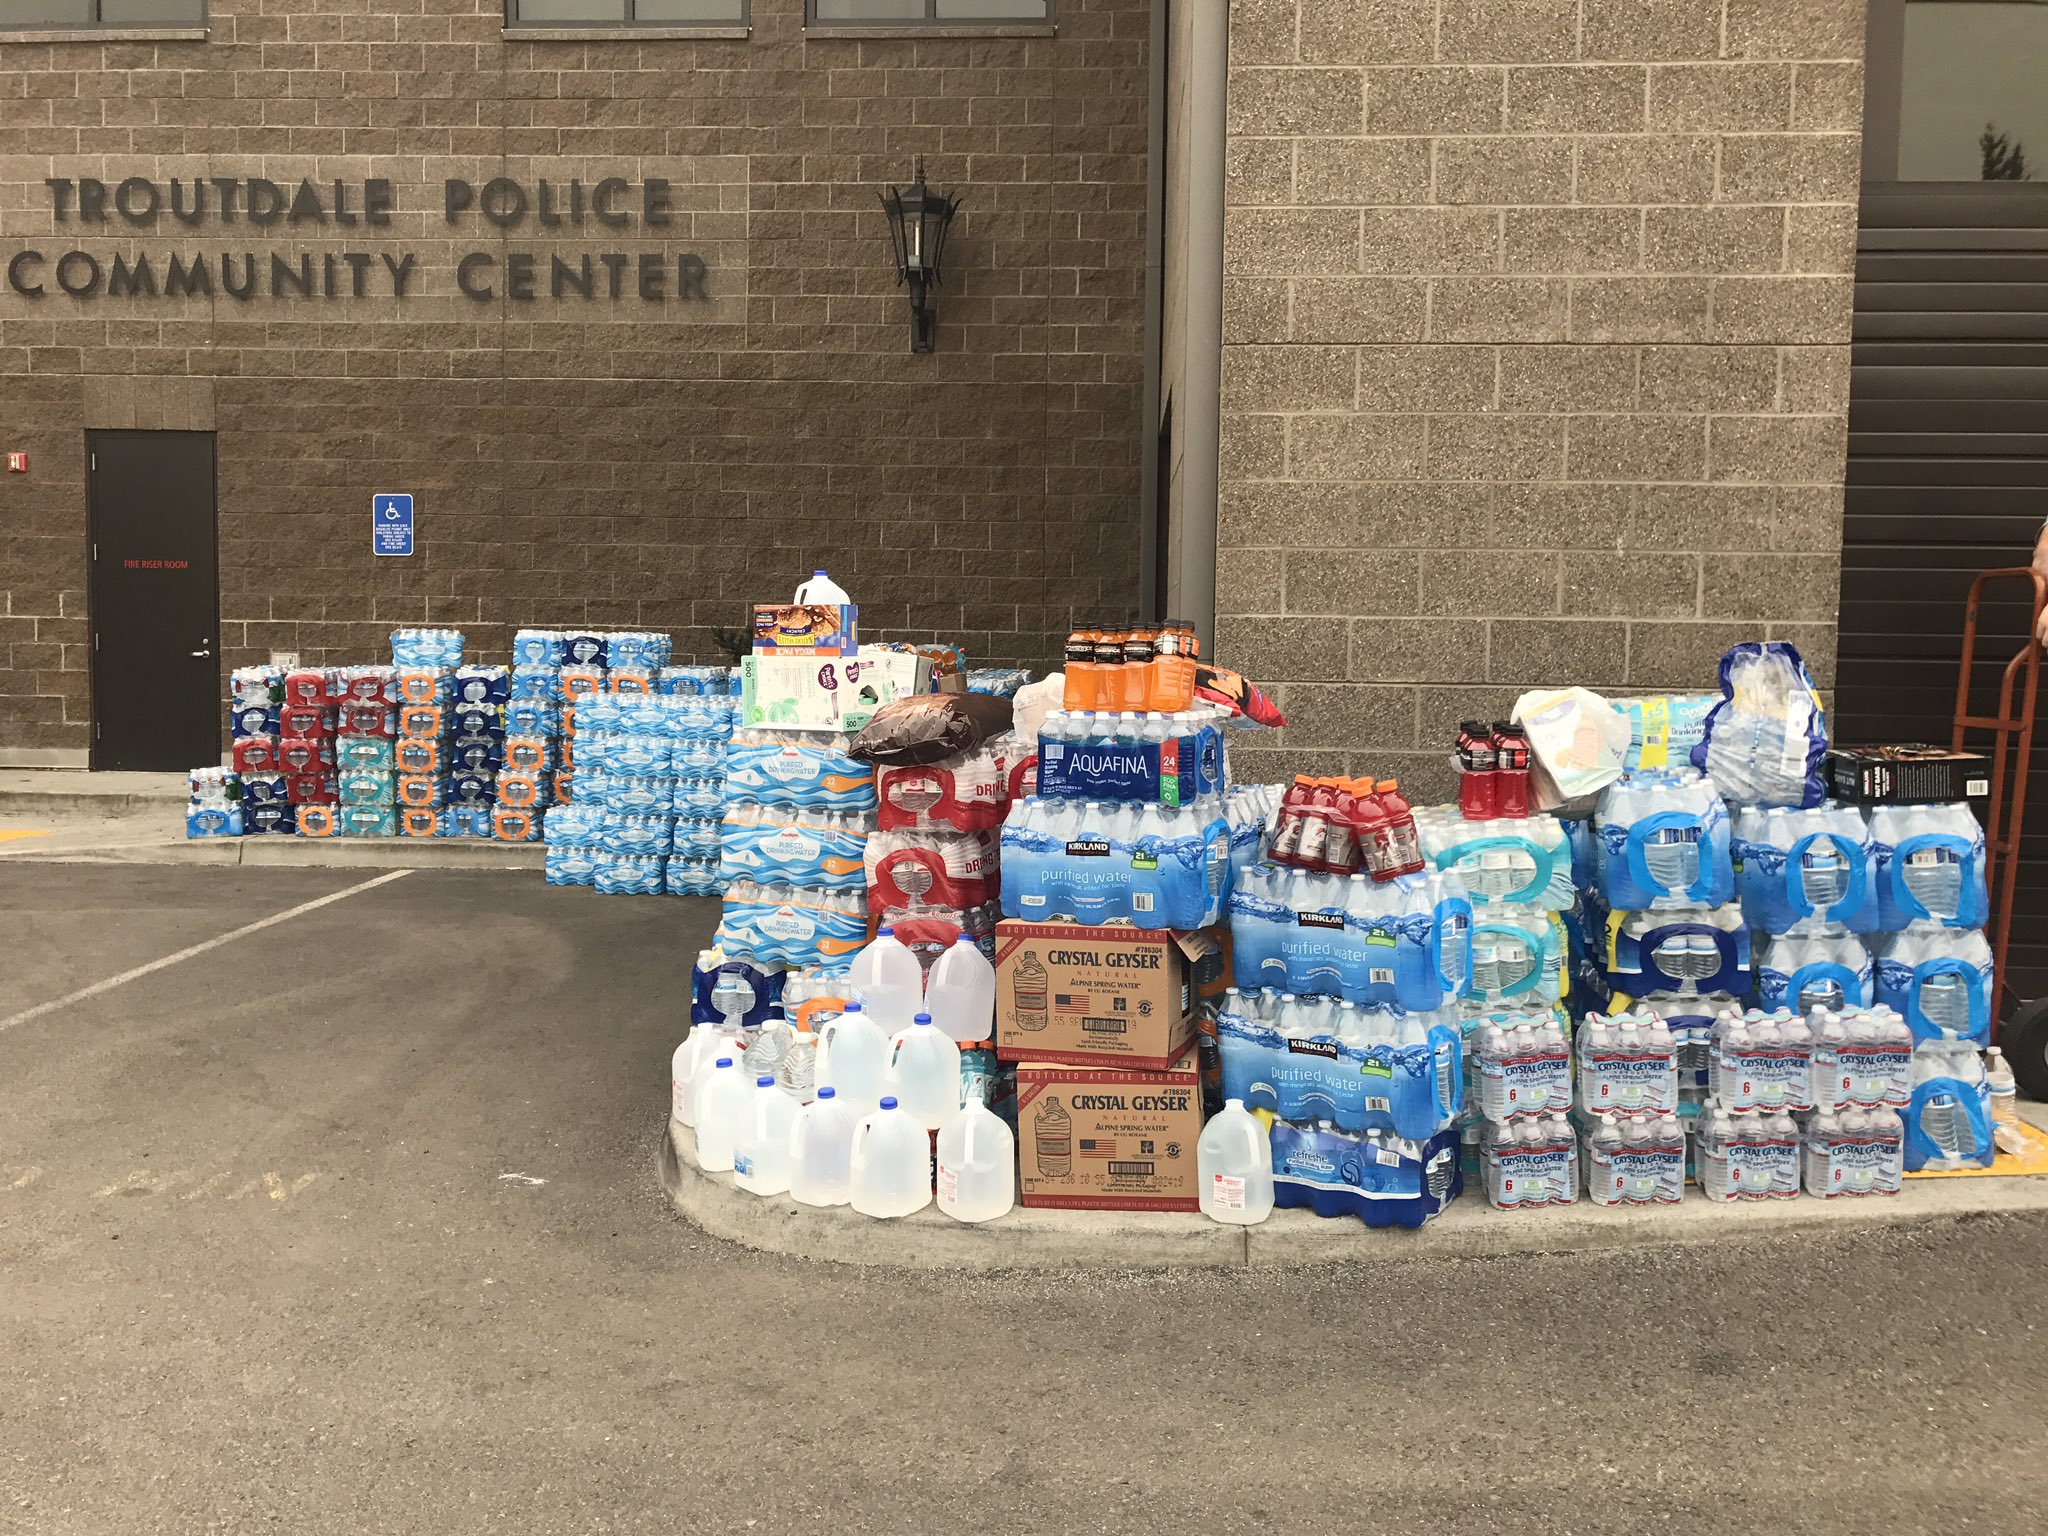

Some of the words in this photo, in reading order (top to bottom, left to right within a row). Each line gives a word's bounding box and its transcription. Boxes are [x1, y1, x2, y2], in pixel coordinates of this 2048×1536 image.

[45, 176, 391, 224] TROUTDALE
[444, 177, 670, 226] POLICE
[7, 250, 415, 298] COMMUNITY
[456, 252, 709, 300] CENTER
[124, 560, 140, 568] FIRE
[142, 560, 162, 568] RISER
[164, 560, 188, 568] ROOM
[776, 648, 793, 656] PACK
[794, 648, 816, 656] MEGA
[846, 720, 856, 728] 500
[1068, 752, 1150, 778] AQUAFINA
[1163, 756, 1176, 766] 24
[1068, 843, 1108, 851] KIRKLAND
[1136, 852, 1144, 860] 21
[827, 860, 836, 868] 32
[1042, 868, 1088, 884] purified
[1093, 872, 1132, 884] water
[1301, 914, 1342, 924] KIRKLAND
[1006, 926, 1055, 936] BOTTLED
[1114, 931, 1160, 940] SOURCE
[1373, 928, 1384, 936] 21
[822, 941, 830, 949] 32
[1282, 941, 1330, 954] purified
[1334, 947, 1368, 962] water
[1048, 950, 1102, 966] CRYSTAL
[1105, 952, 1160, 969] GEYSER
[1076, 970, 1138, 978] NATURAL
[1070, 978, 1093, 987] ALPINE
[1117, 982, 1140, 990] WATER
[1291, 1040, 1336, 1054] KIRKLAND
[1741, 1059, 1773, 1068] CRYSTAL
[1775, 1059, 1805, 1068] GEYSER
[1840, 1055, 1875, 1064] CRYSTAL
[1876, 1054, 1908, 1063] GEYSER
[1506, 1065, 1537, 1076] CRYSTAL
[1538, 1060, 1567, 1070] GEYSER
[1598, 1062, 1631, 1071] CRYSTAL
[1633, 1062, 1666, 1071] GEYSER
[1028, 1072, 1079, 1080] BOTTLED
[1089, 1072, 1101, 1080] AT
[1112, 1073, 1132, 1081] THE
[1142, 1074, 1188, 1082] SOURCE
[1272, 1066, 1321, 1081] purified
[1325, 1074, 1362, 1091] water
[1744, 1082, 1750, 1094] 6
[1843, 1077, 1850, 1089] 6
[1510, 1089, 1516, 1100] 6
[1602, 1084, 1608, 1095] 6
[1072, 1095, 1128, 1110] CRYSTAL
[1133, 1096, 1189, 1111] GEYSER
[1095, 1123, 1119, 1131] ALPINE
[1730, 1147, 1761, 1156] CRYSTAL
[1762, 1146, 1792, 1156] GEYSER
[1833, 1145, 1864, 1156] CRYSTAL
[1866, 1144, 1896, 1154] GEYSER
[1292, 1150, 1328, 1163] refreshe
[1502, 1155, 1532, 1166] CRYSTAL
[1533, 1154, 1564, 1164] GEYSER
[1614, 1155, 1645, 1165] CRYSTAL
[1647, 1154, 1678, 1163] GEYSER
[1733, 1169, 1739, 1180] 6
[1835, 1169, 1841, 1180] 6
[1506, 1180, 1513, 1190] 6
[1616, 1177, 1623, 1188] 6
